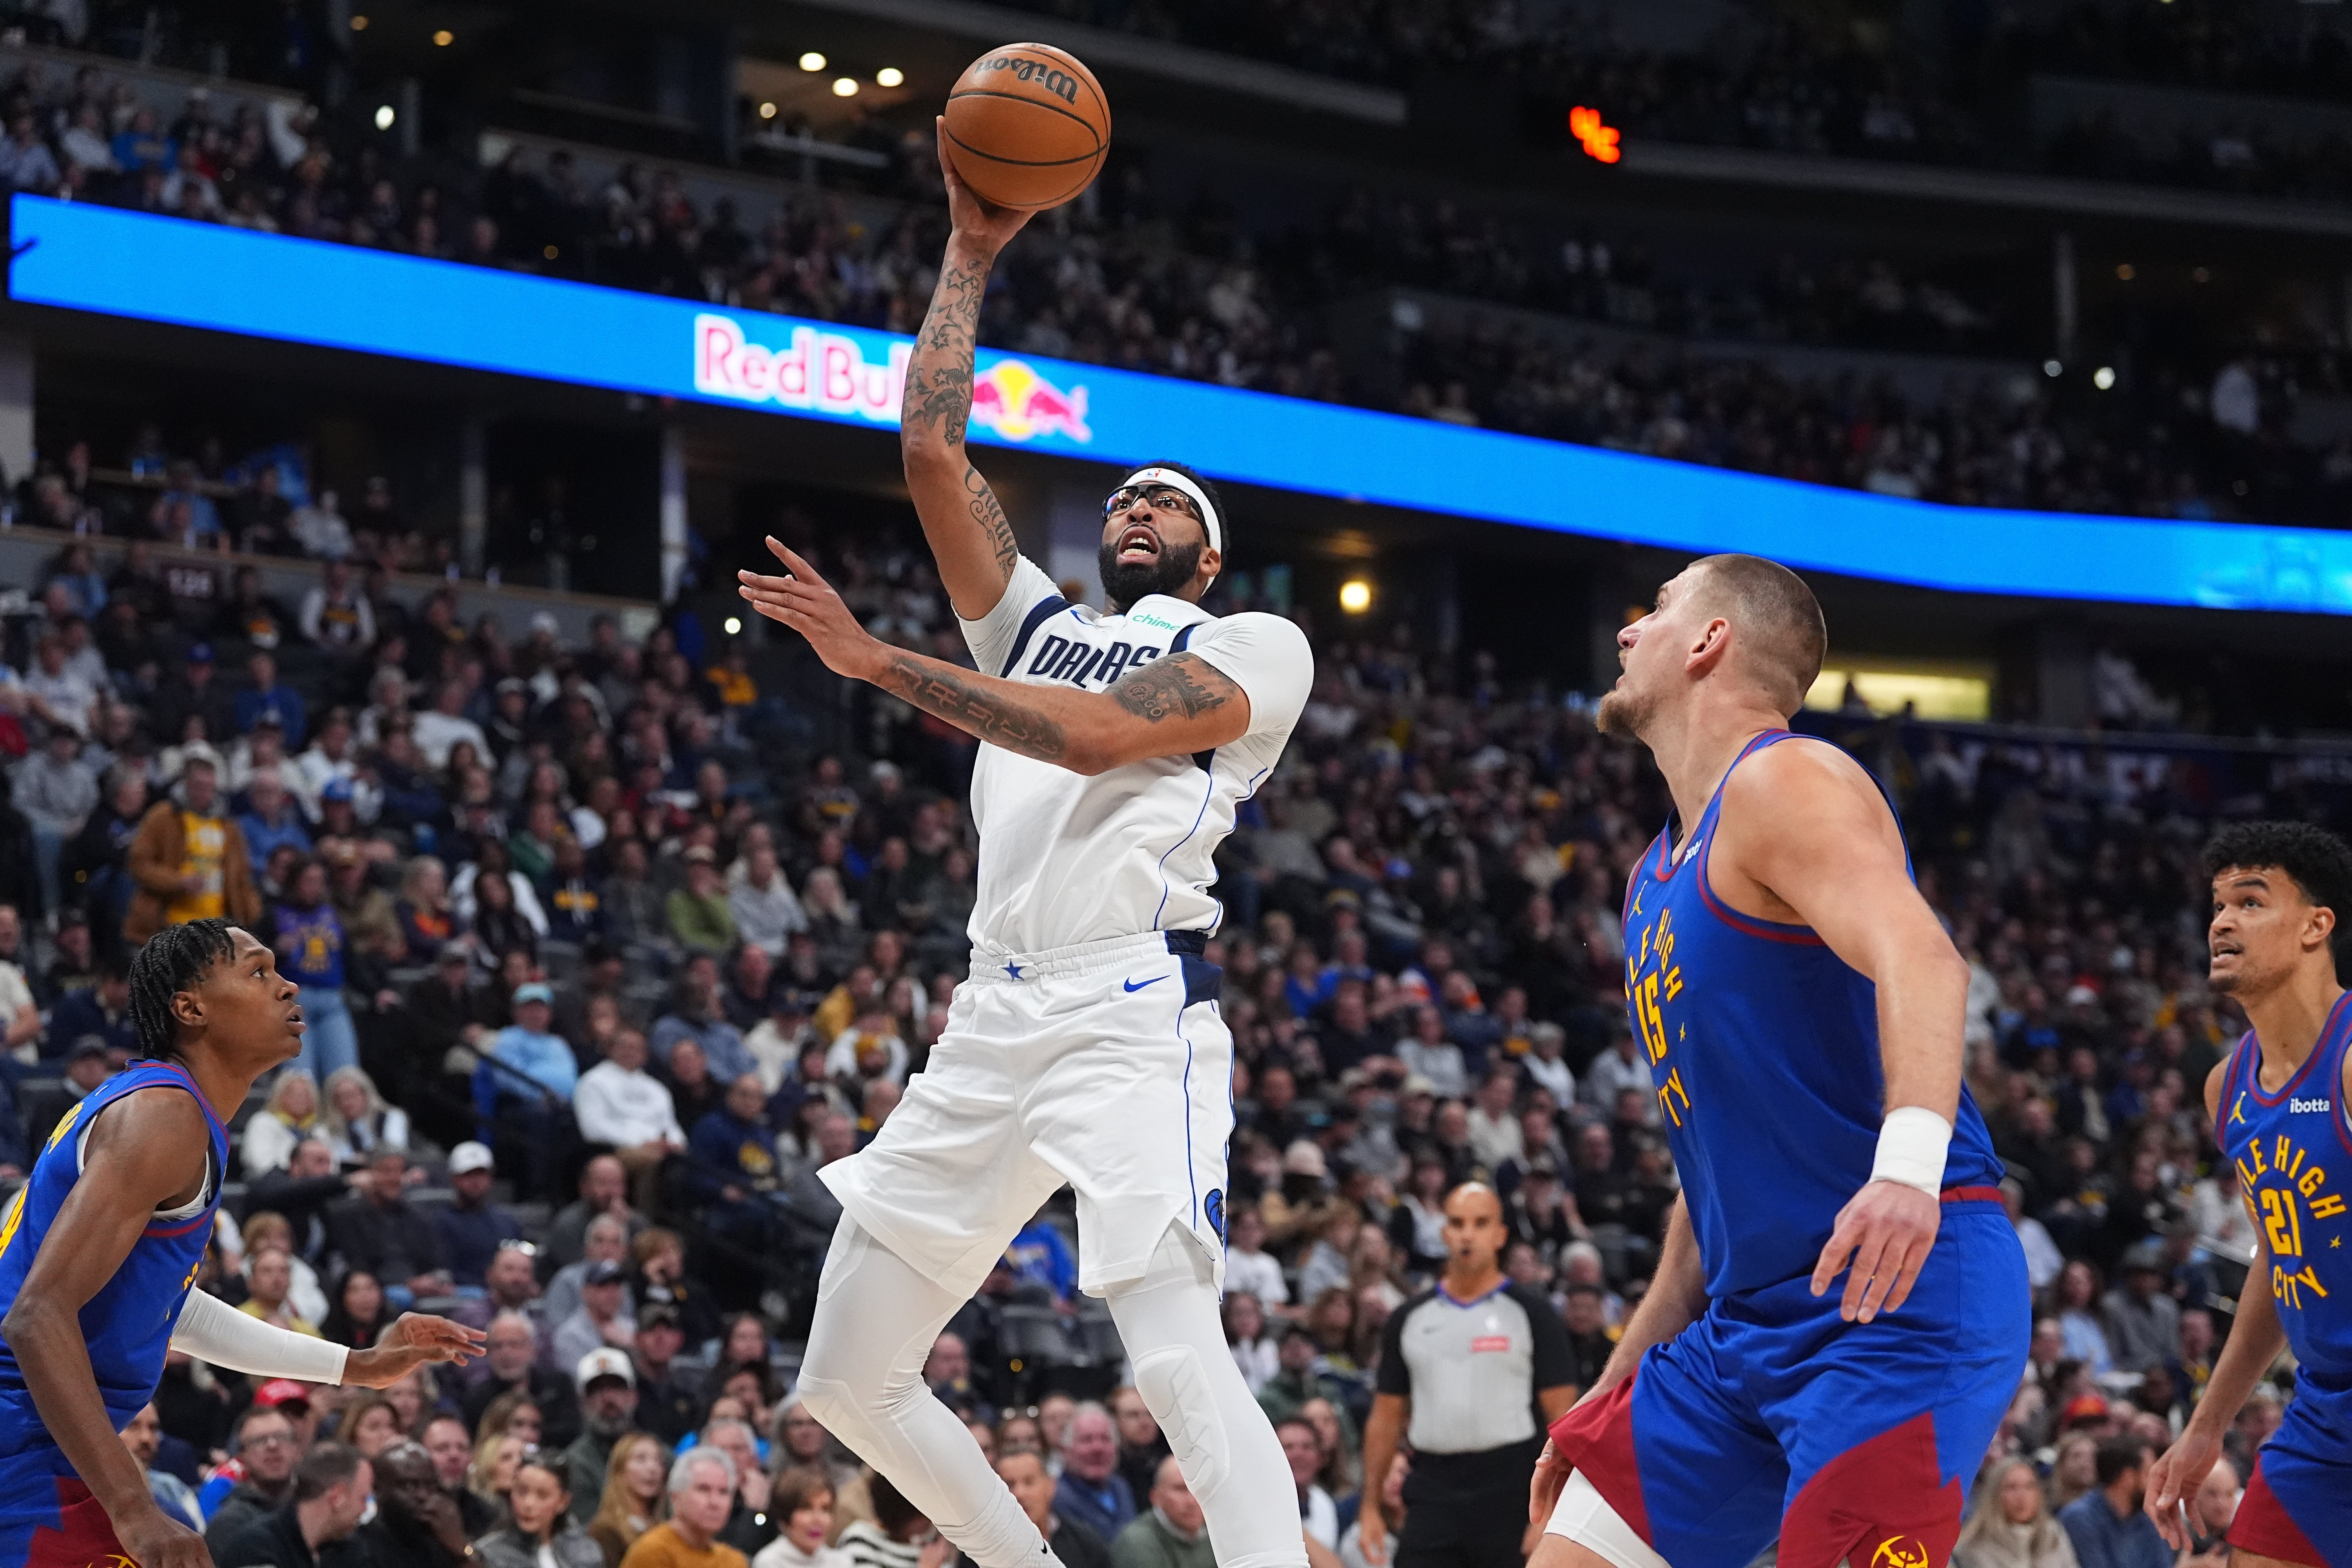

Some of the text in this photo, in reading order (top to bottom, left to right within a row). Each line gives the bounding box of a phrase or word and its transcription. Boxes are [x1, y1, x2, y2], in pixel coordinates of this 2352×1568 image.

[975, 57, 1078, 105] Wilson
[700, 318, 910, 416] Red Bul
[1132, 614, 1181, 631] chime
[1653, 908, 1683, 1002] HIGH
[1634, 970, 1667, 1067] 15
[2290, 1097, 2330, 1114] ibotta
[2274, 1134, 2347, 1220] HIGH
[2260, 1188, 2303, 1256] 21
[2273, 1265, 2328, 1310] CITY
